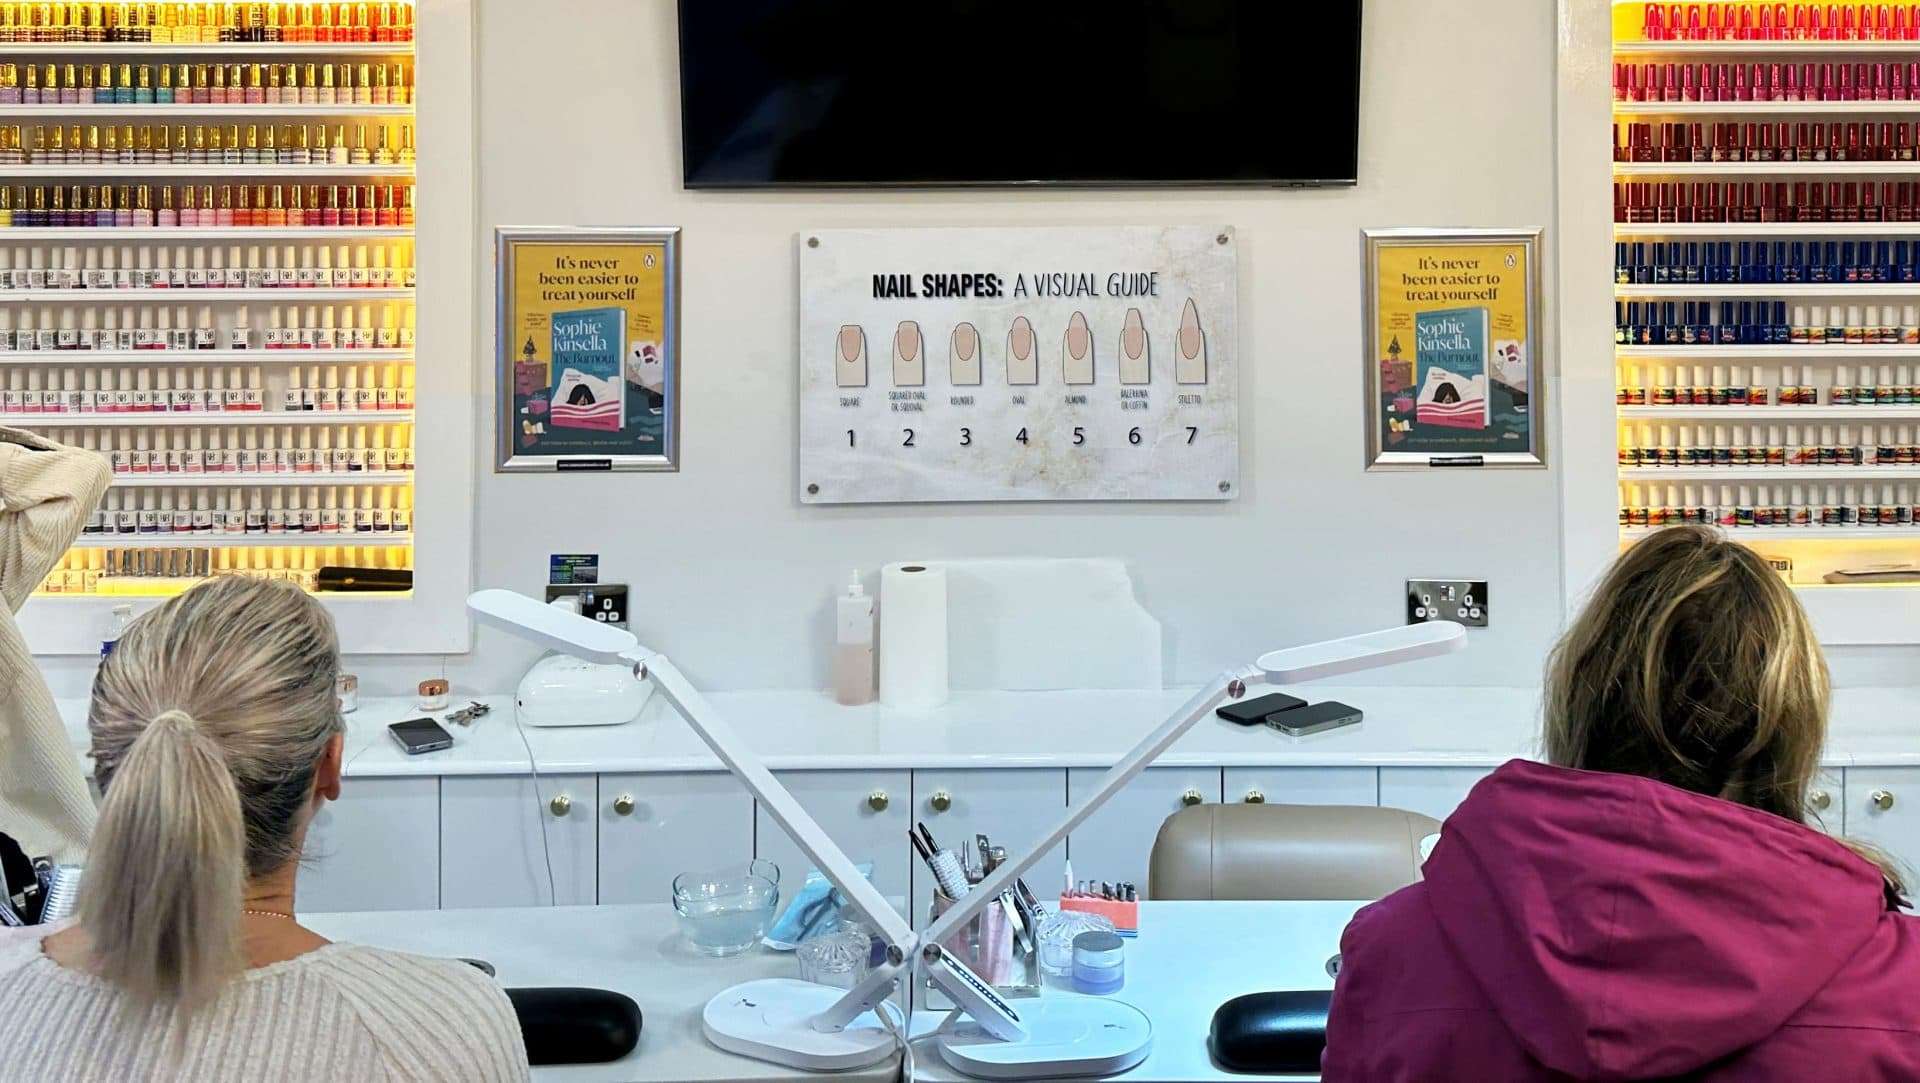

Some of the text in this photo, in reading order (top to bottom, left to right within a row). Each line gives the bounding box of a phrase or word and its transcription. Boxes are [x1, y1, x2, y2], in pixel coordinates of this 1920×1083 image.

[556, 256, 620, 269] It's never
[1418, 256, 1480, 270] It's never
[539, 272, 639, 285] been easier to
[872, 271, 1158, 298] NAIL SHAPES: A VISUAL GUIDE
[1402, 272, 1500, 285] been easier to
[542, 288, 637, 304] treat yourself
[1406, 288, 1499, 304] treat yourself
[553, 319, 602, 339] Sophie
[1417, 318, 1465, 338] Sophie
[554, 334, 607, 352] Kinsella
[1418, 333, 1471, 351] Kinsella
[840, 397, 861, 408] SQUARE
[1012, 395, 1026, 405] OVAL
[1064, 394, 1087, 405] ALMOND
[1177, 394, 1202, 405] STILETTO
[847, 429, 855, 447] 1
[902, 428, 915, 447] 2
[959, 427, 972, 446] 3
[1015, 427, 1029, 445] 4
[1073, 426, 1085, 445] 5
[1128, 426, 1141, 445] 6
[1185, 426, 1198, 444] 7
